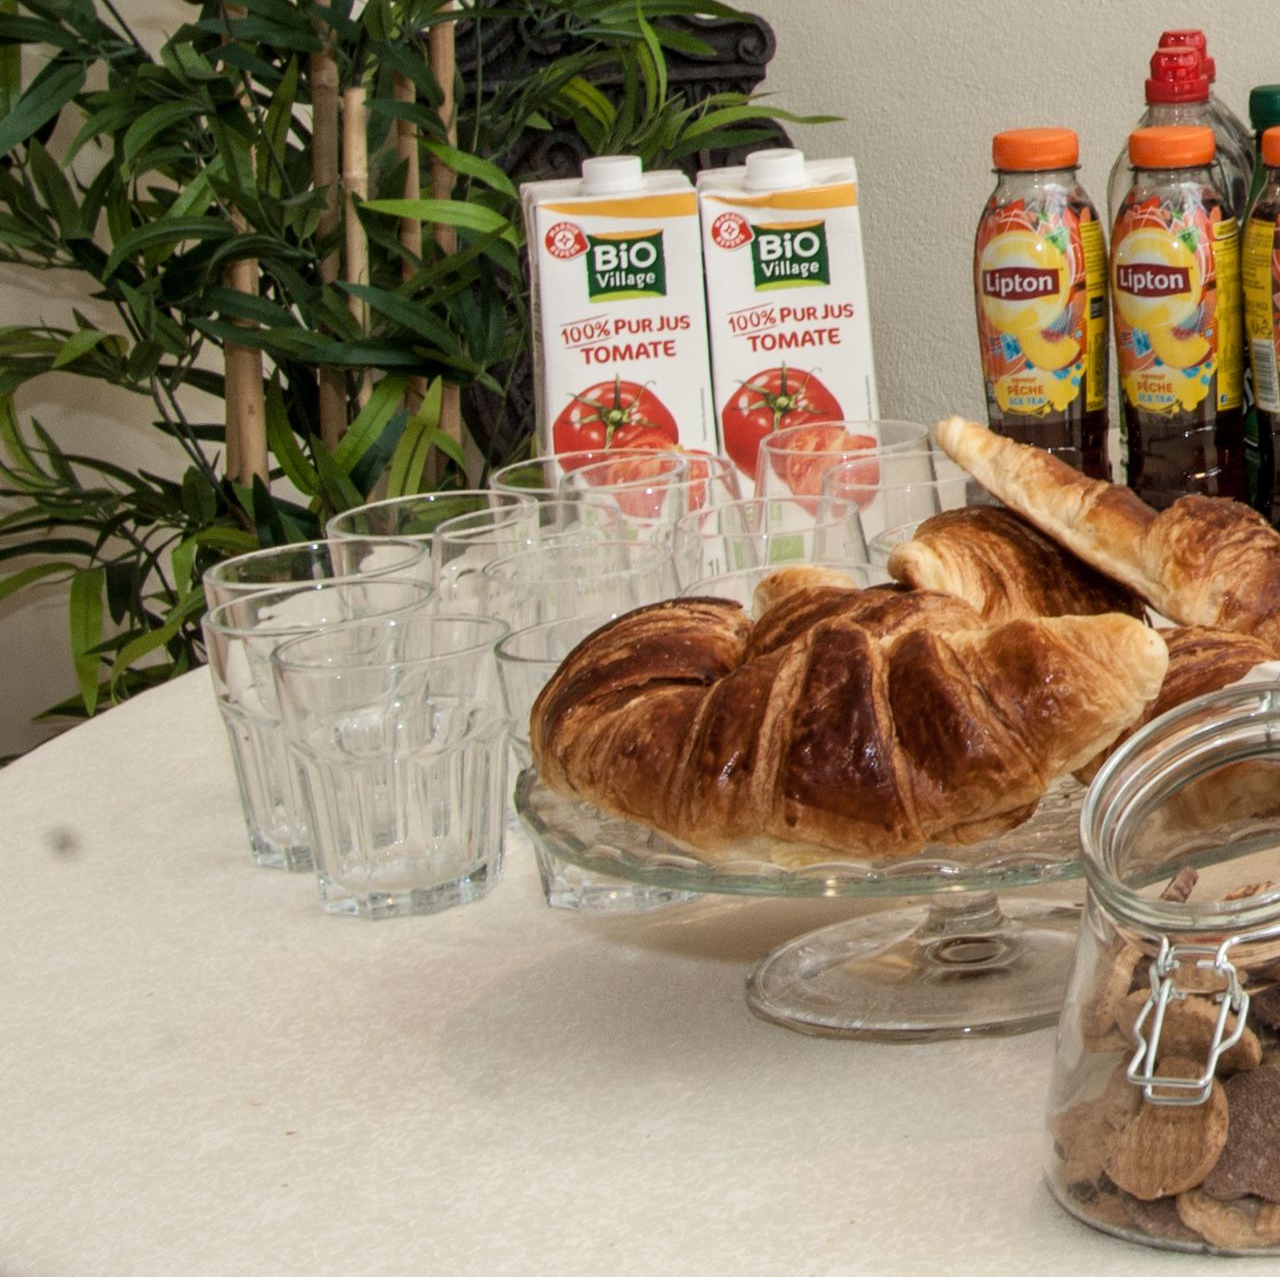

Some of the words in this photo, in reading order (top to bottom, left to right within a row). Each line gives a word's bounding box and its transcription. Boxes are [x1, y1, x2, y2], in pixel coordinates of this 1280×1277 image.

[596, 271, 656, 289] Village
[761, 260, 820, 278] Village
[1119, 269, 1184, 293] Lipton
[985, 273, 1053, 297] Lipton
[561, 320, 611, 344] 100%
[614, 318, 653, 335] PUR
[656, 315, 691, 332] JUS
[728, 308, 777, 333] 100%
[780, 306, 818, 323] PUR
[821, 303, 854, 320] JUS
[580, 339, 677, 364] TOMATE
[747, 327, 842, 353] TOMATE
